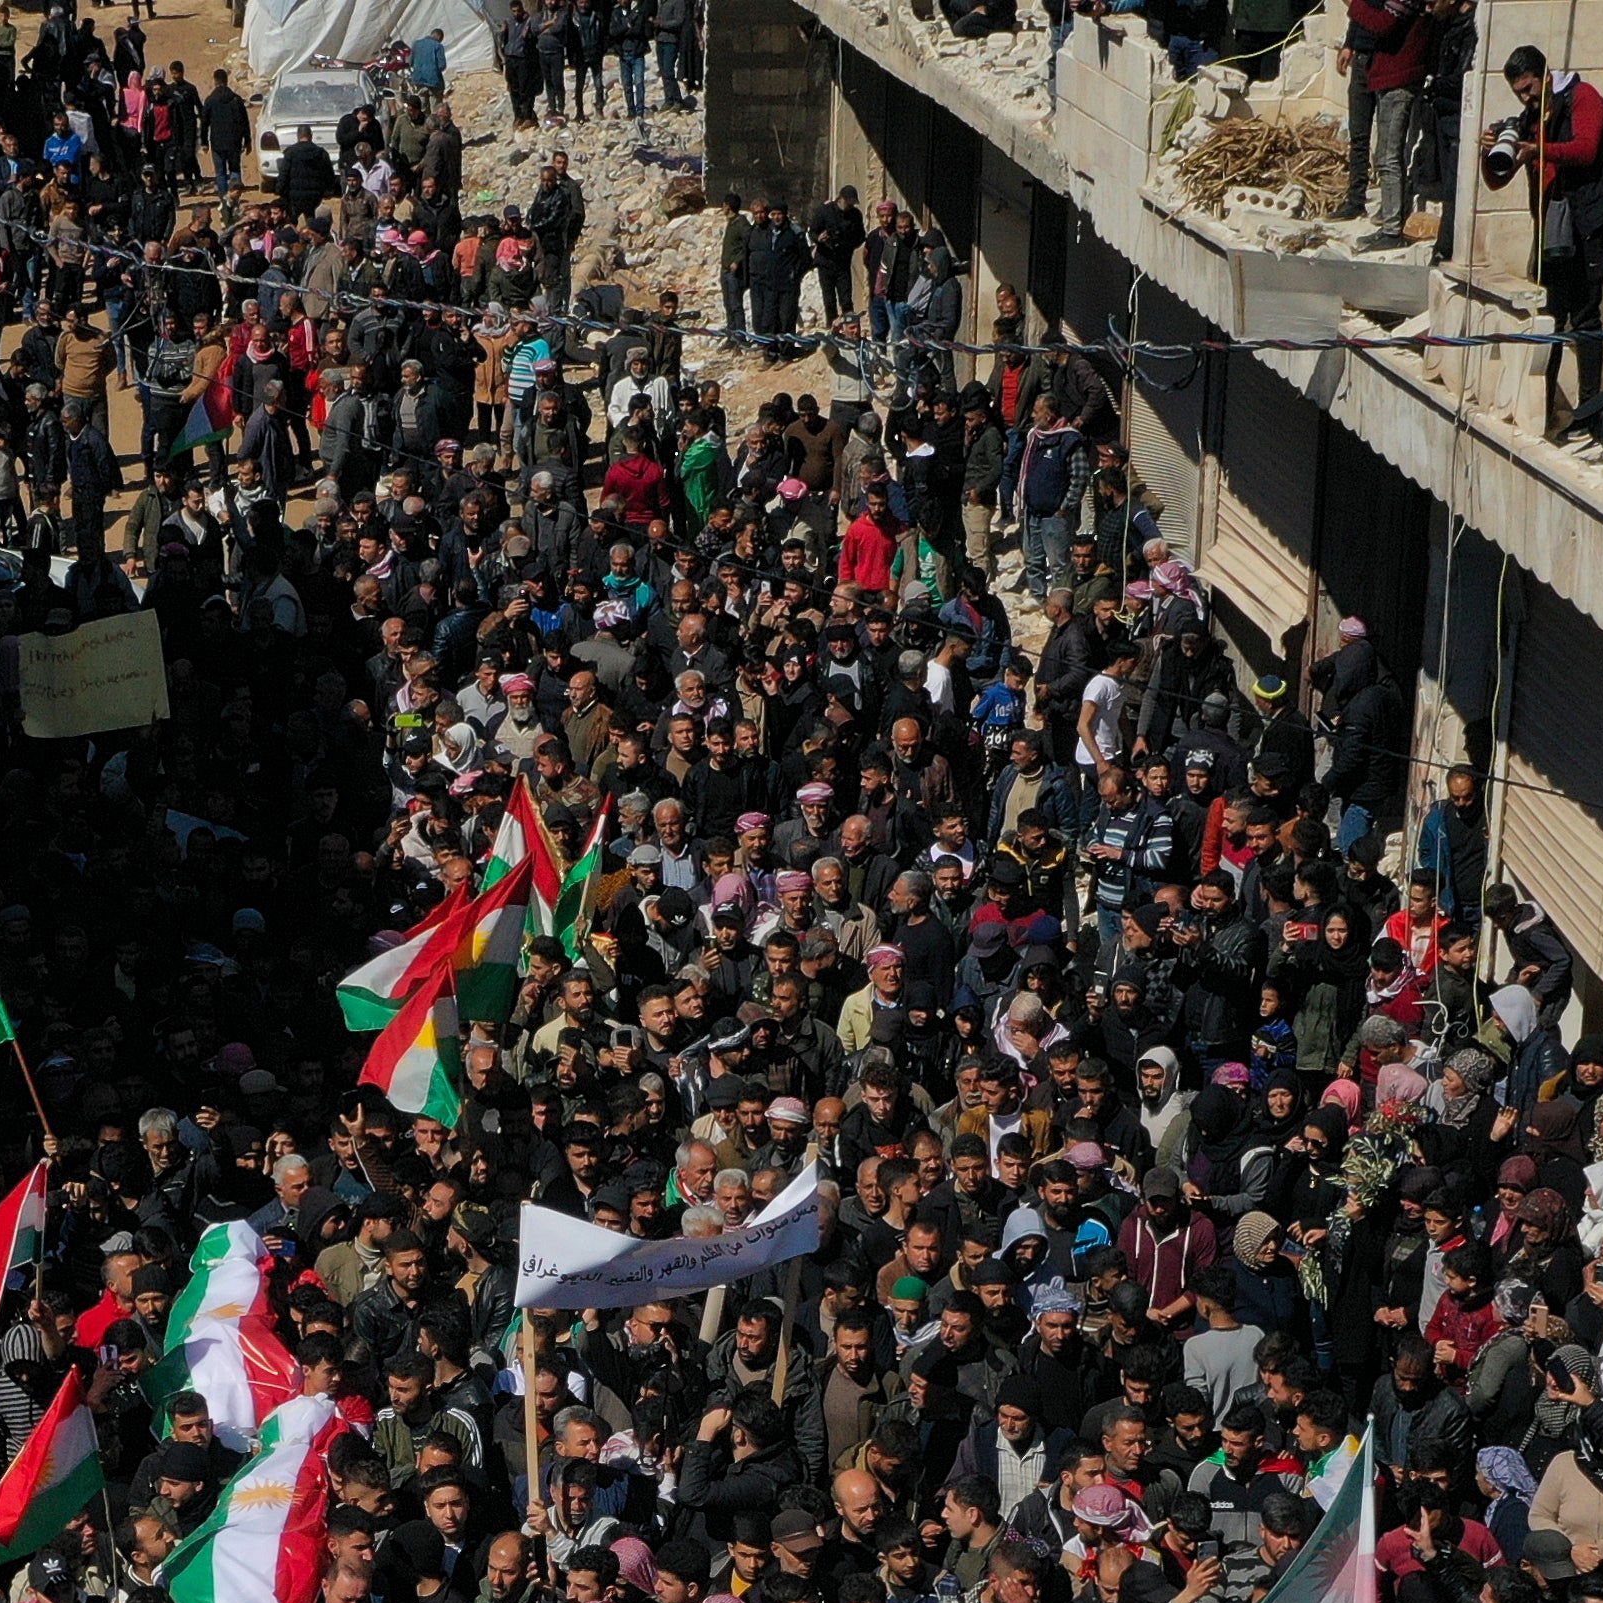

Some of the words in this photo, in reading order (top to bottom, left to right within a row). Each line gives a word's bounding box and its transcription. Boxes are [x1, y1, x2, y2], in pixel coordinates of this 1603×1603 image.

[791, 1203, 819, 1224] مس
[700, 1242, 726, 1270] الظلم
[725, 1240, 744, 1257] من
[522, 1253, 603, 1287] الديموغرافي
[658, 1253, 697, 1280] والقهر
